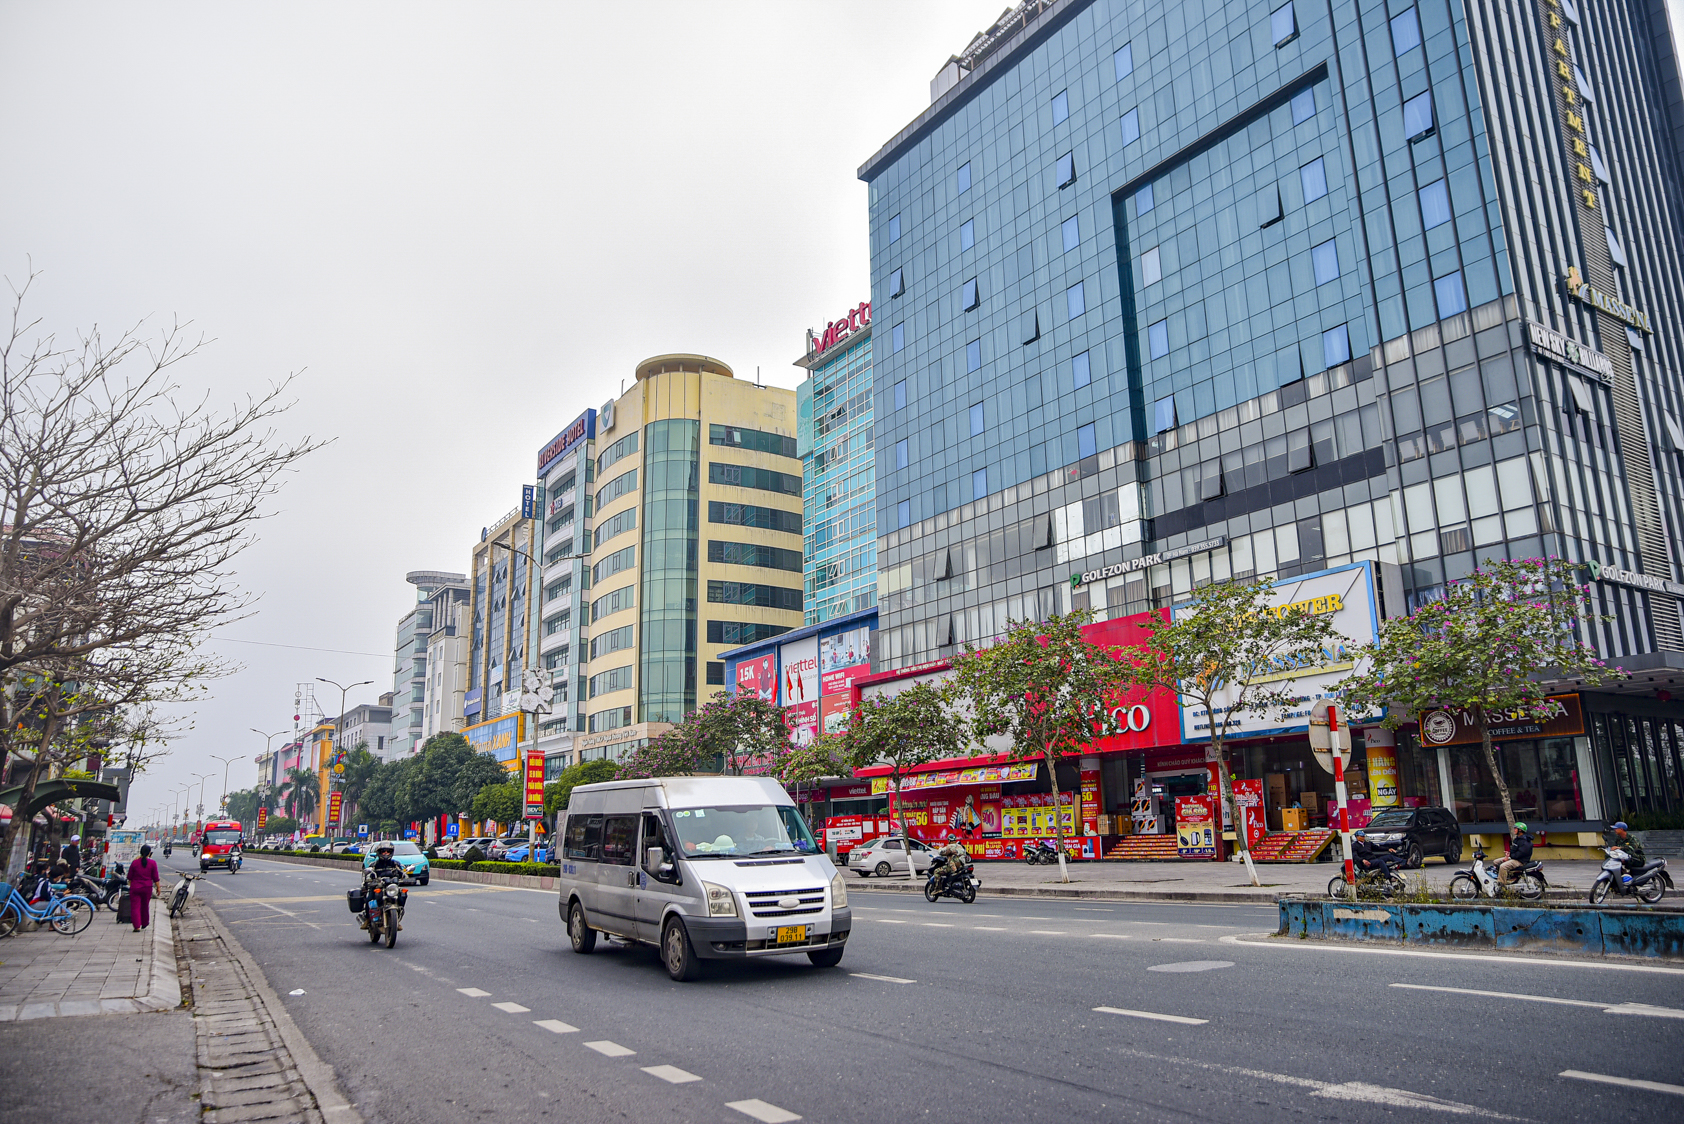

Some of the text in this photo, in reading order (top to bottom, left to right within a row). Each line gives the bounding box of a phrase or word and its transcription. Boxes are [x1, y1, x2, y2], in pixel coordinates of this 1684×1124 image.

[813, 301, 872, 354] viett
[1530, 324, 1550, 350] NEW
[1550, 334, 1565, 356] SKY
[567, 418, 586, 447] HOTEL
[1082, 561, 1130, 582] GOLFZON
[1132, 552, 1162, 570] PARK
[1602, 566, 1643, 586] GOLFZON
[1643, 574, 1666, 592] PARK
[740, 665, 754, 682] 15K
[1488, 727, 1515, 736] COFFEE
[493, 730, 512, 750] XANH
[1372, 756, 1395, 767] HÀNG
[1383, 766, 1396, 775] ĐẾN
[1082, 792, 1093, 801] 50
[1377, 788, 1397, 796] NGÀY
[916, 812, 928, 826] 50
[974, 841, 985, 854] PHÍ
[780, 934, 802, 942] 039.11
